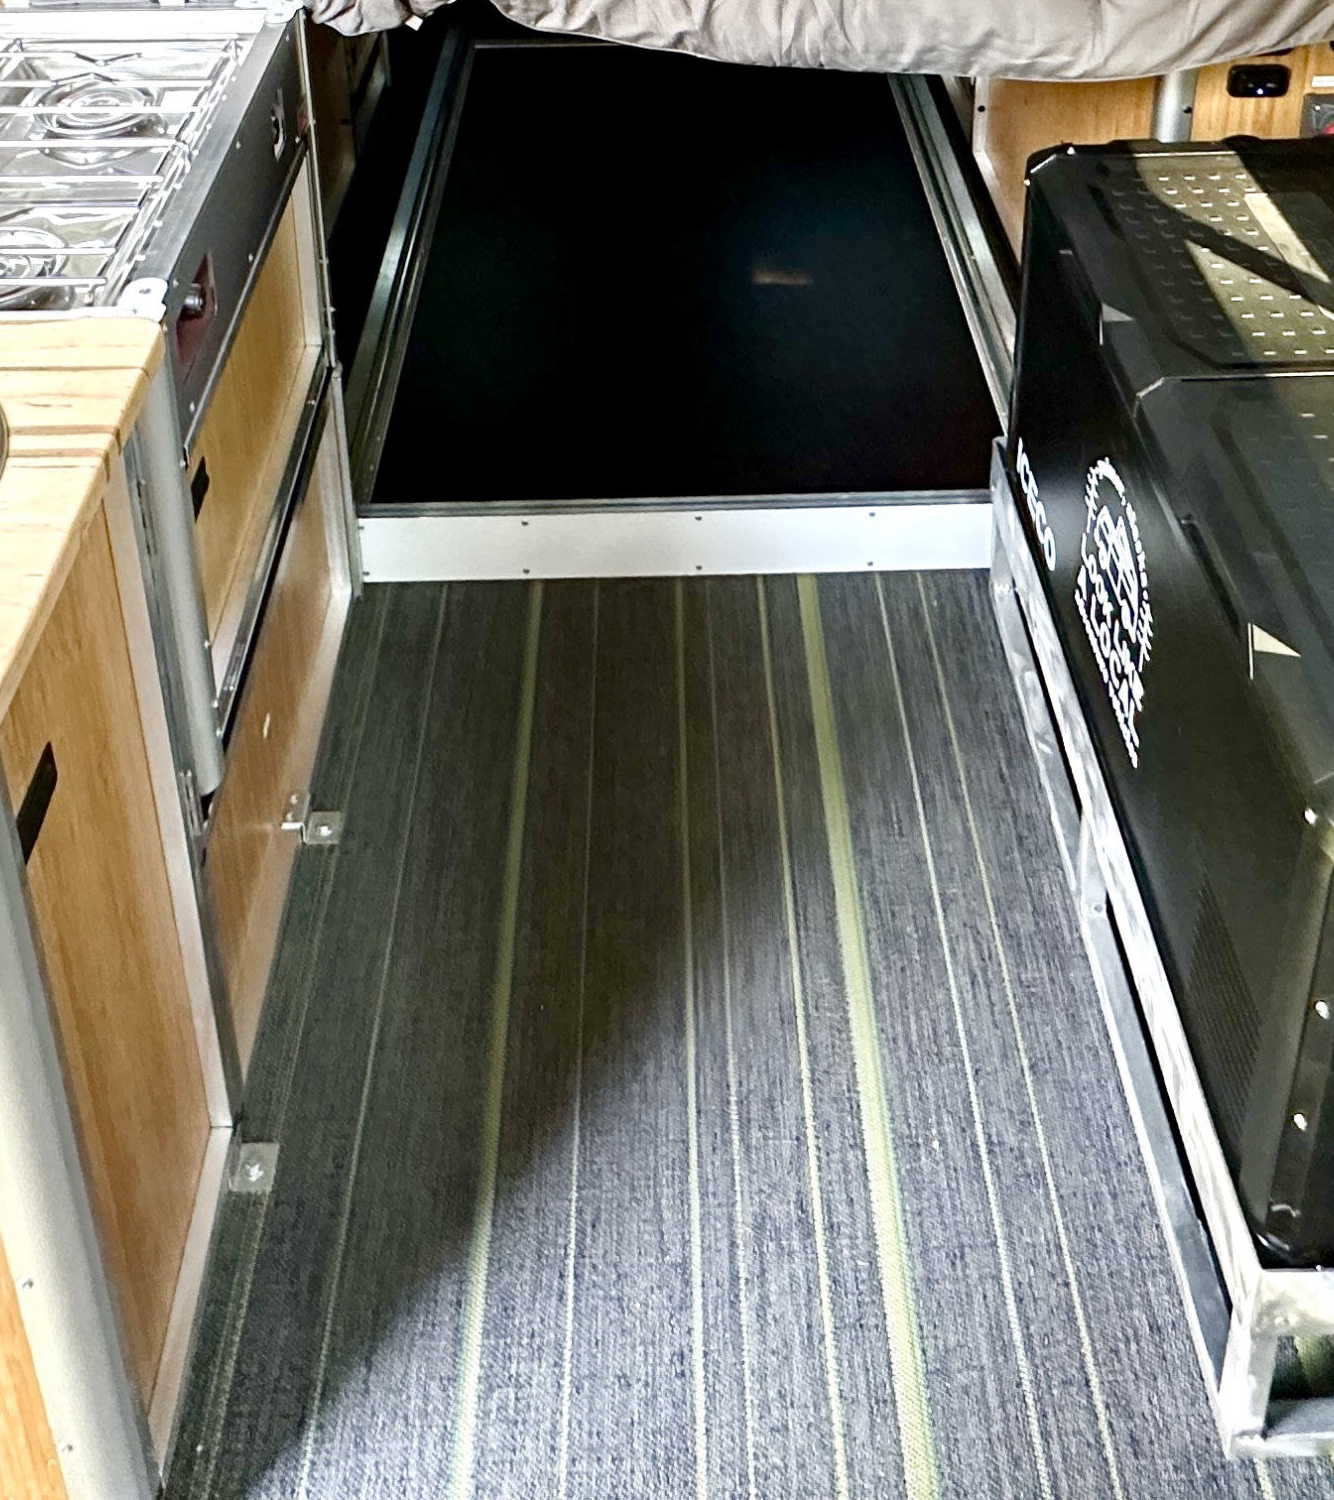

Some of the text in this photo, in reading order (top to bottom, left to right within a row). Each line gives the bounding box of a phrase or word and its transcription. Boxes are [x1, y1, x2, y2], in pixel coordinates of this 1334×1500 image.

[1017, 437, 1056, 571] ICECO
[1080, 532, 1113, 631] LOOK
[1089, 594, 1140, 749] LOCAL
